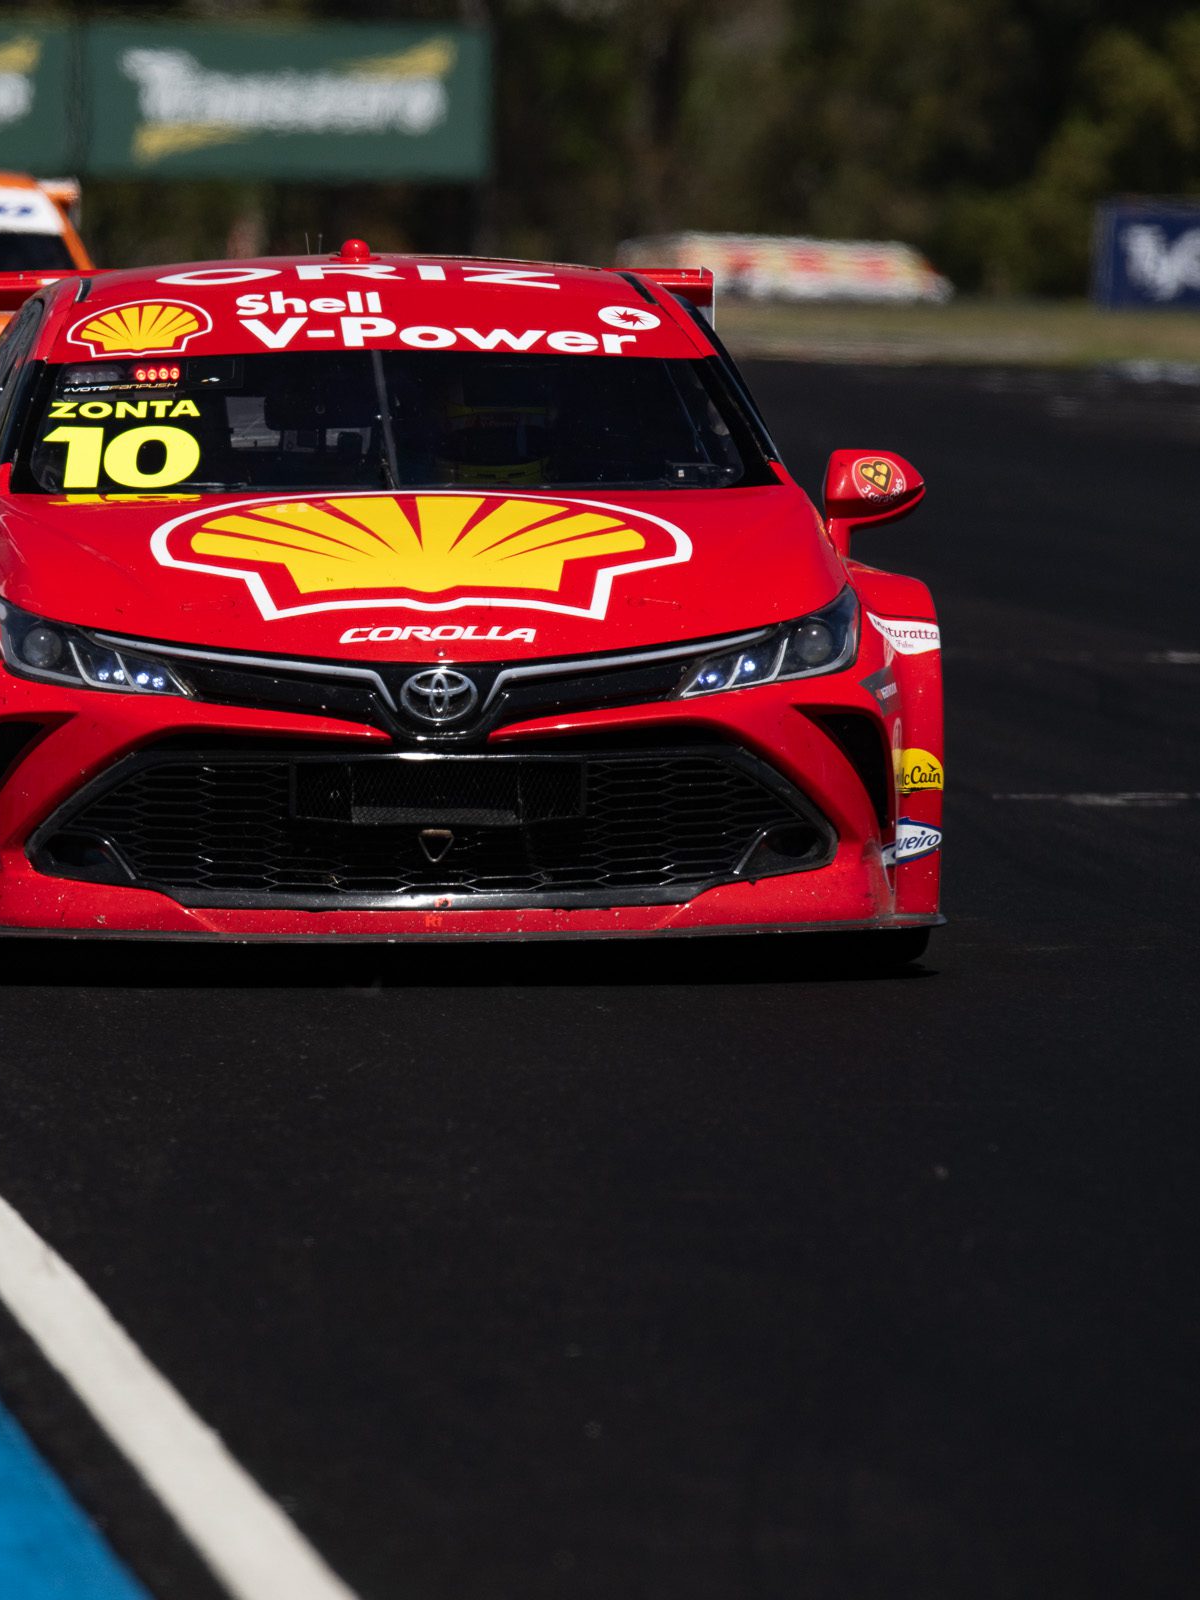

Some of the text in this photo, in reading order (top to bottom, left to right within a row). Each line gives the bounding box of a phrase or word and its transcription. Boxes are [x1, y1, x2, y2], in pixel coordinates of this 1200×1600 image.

[236, 291, 382, 315] Shell
[239, 316, 637, 354] V-Power
[48, 400, 201, 419] ZONTA
[42, 425, 201, 489] 10
[339, 625, 536, 643] COROLLA
